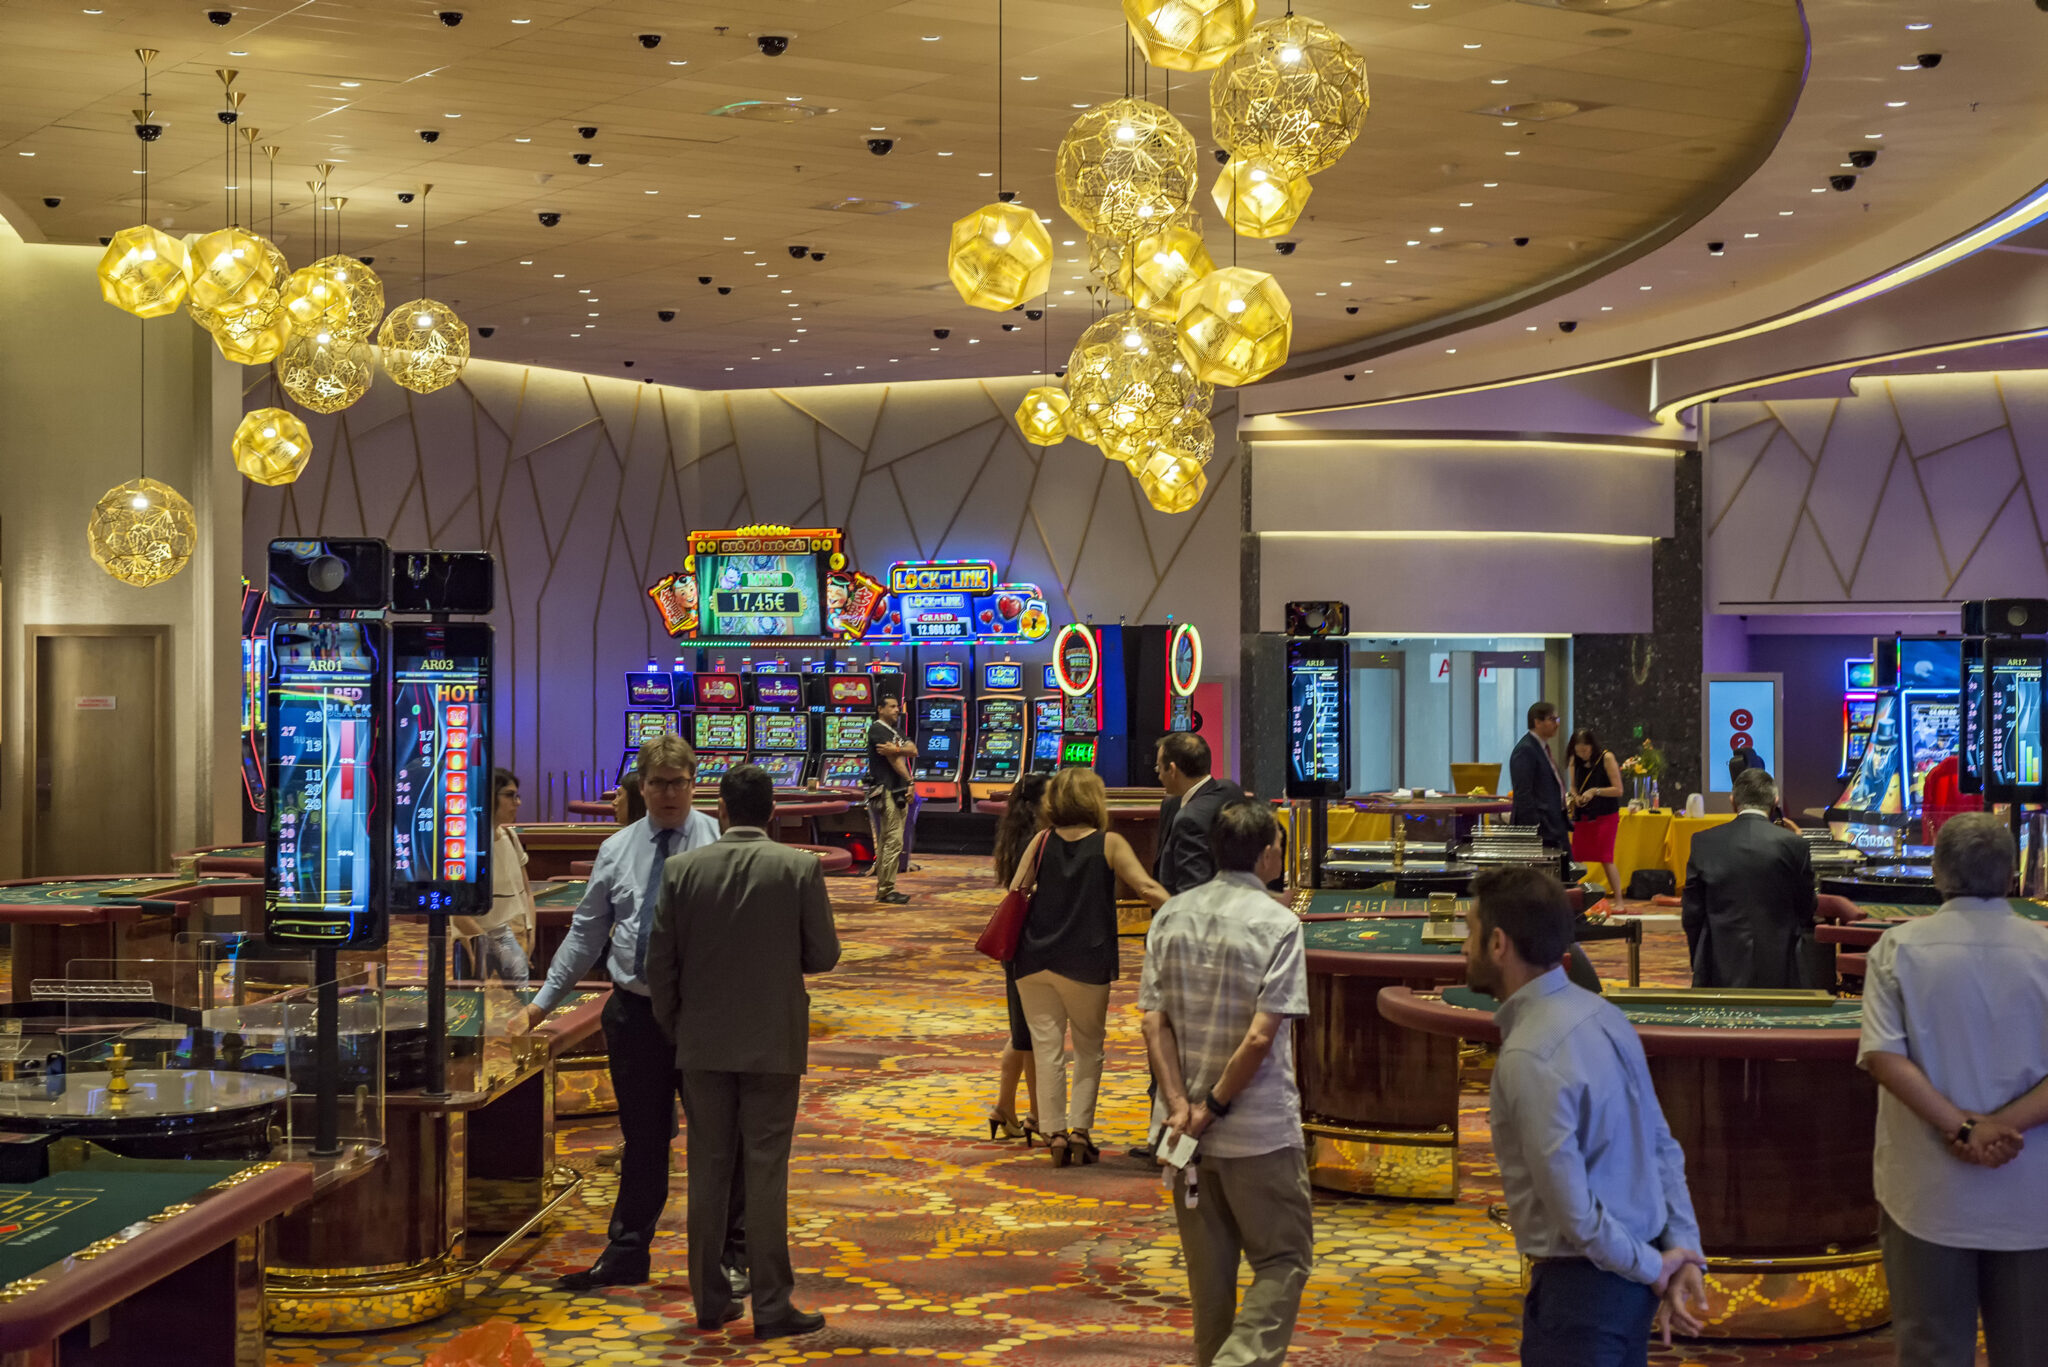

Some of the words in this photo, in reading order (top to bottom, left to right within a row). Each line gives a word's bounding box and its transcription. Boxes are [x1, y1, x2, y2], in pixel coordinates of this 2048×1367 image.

[748, 572, 782, 586] MINI
[896, 568, 940, 589] LOCK
[951, 570, 986, 588] LINK
[732, 593, 785, 612] 17,45€
[922, 614, 953, 622] GRAND
[308, 660, 342, 672] AR01
[421, 660, 454, 670] AR03
[775, 681, 782, 689] 5
[334, 687, 362, 700] RED
[438, 685, 478, 702] HOT
[326, 704, 372, 718] BLACK
[930, 710, 940, 718] SG
[306, 711, 322, 722] 28
[1736, 714, 1747, 726] C
[400, 718, 408, 728] 5
[281, 726, 296, 736] 27
[420, 730, 434, 741] 17
[306, 740, 322, 752] 13
[928, 738, 940, 747] SG
[422, 743, 432, 754] 6
[281, 756, 296, 766] 27
[422, 756, 430, 766] 2
[305, 769, 321, 781] 11
[399, 770, 408, 778] 9
[304, 799, 321, 810] 28
[396, 796, 410, 804] 14
[448, 799, 464, 809] 14
[418, 821, 433, 831] 10
[280, 844, 295, 853] 12
[452, 843, 460, 852] 9
[396, 860, 409, 869] 19
[448, 865, 462, 876] 10
